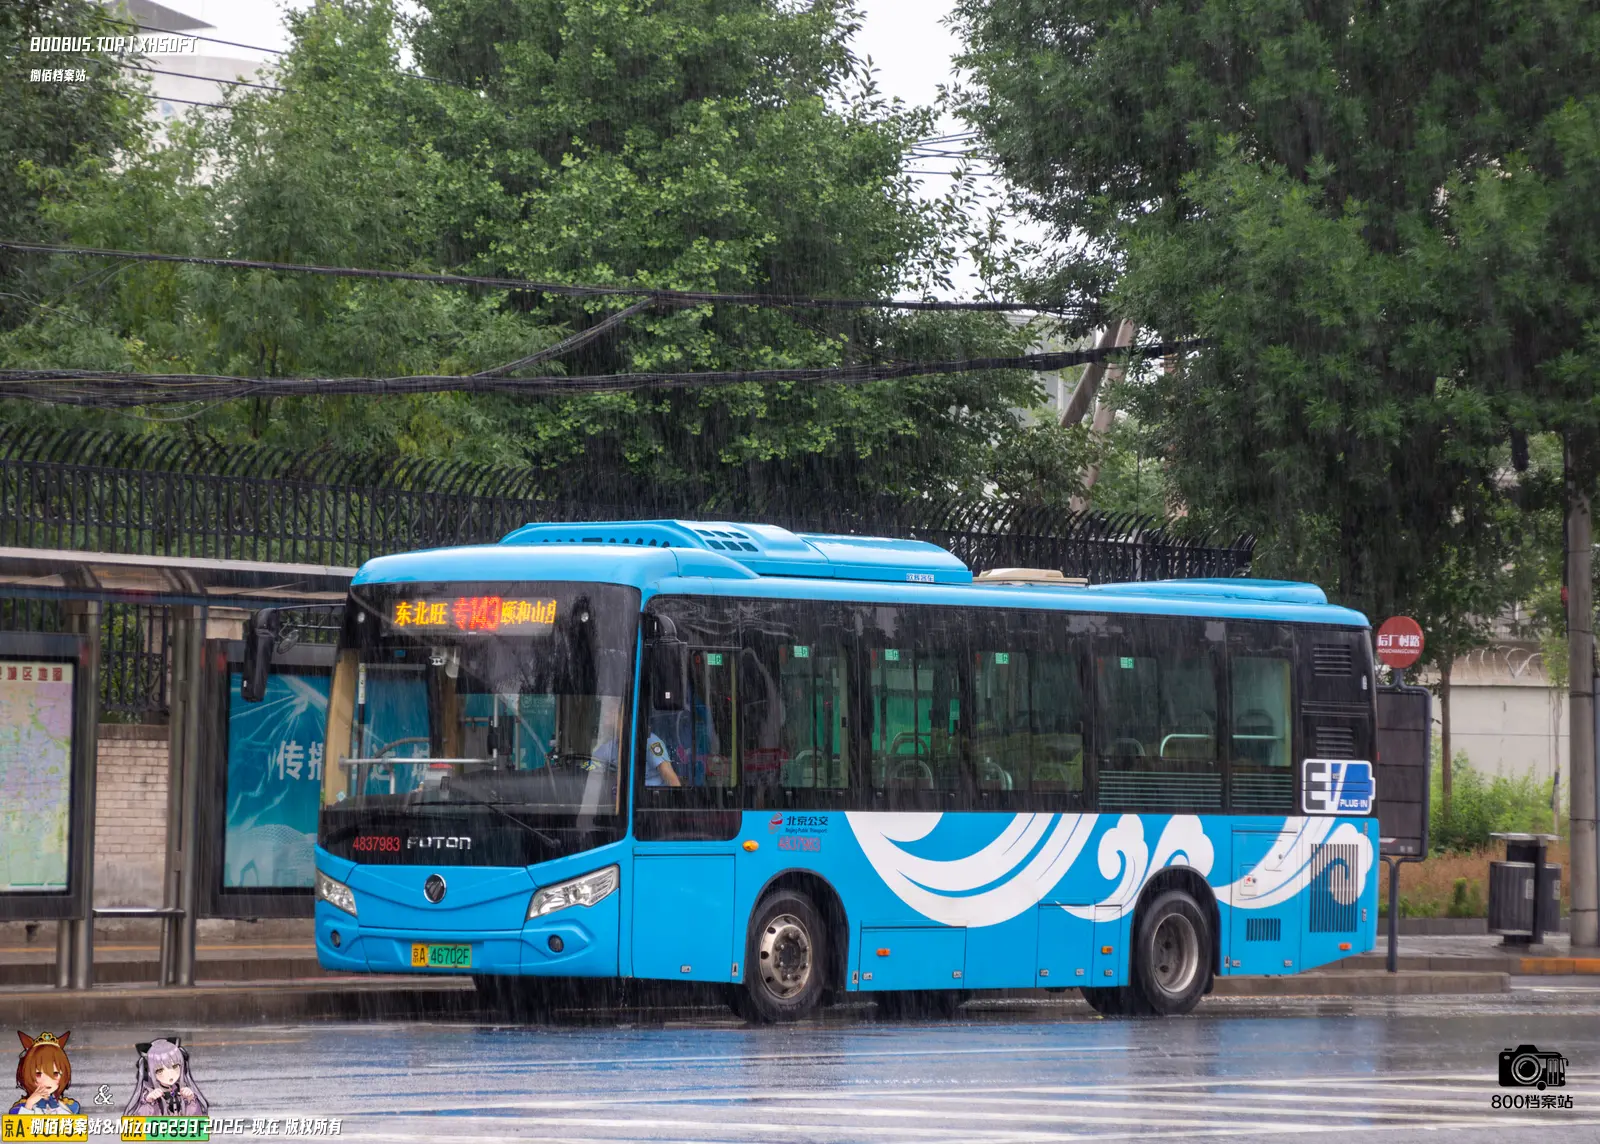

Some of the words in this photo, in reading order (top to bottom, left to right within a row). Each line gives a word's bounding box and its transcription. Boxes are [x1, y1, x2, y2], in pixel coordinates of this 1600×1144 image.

[394, 601, 448, 627] 东北旺
[1377, 634, 1420, 647] 后厂村路
[0, 666, 63, 681] 城区地图
[1339, 799, 1368, 808] PLUG-IN
[786, 815, 829, 826] 北京公交
[352, 836, 400, 851] 4837983
[406, 836, 471, 850] FOTON
[778, 835, 821, 852] 4837983
